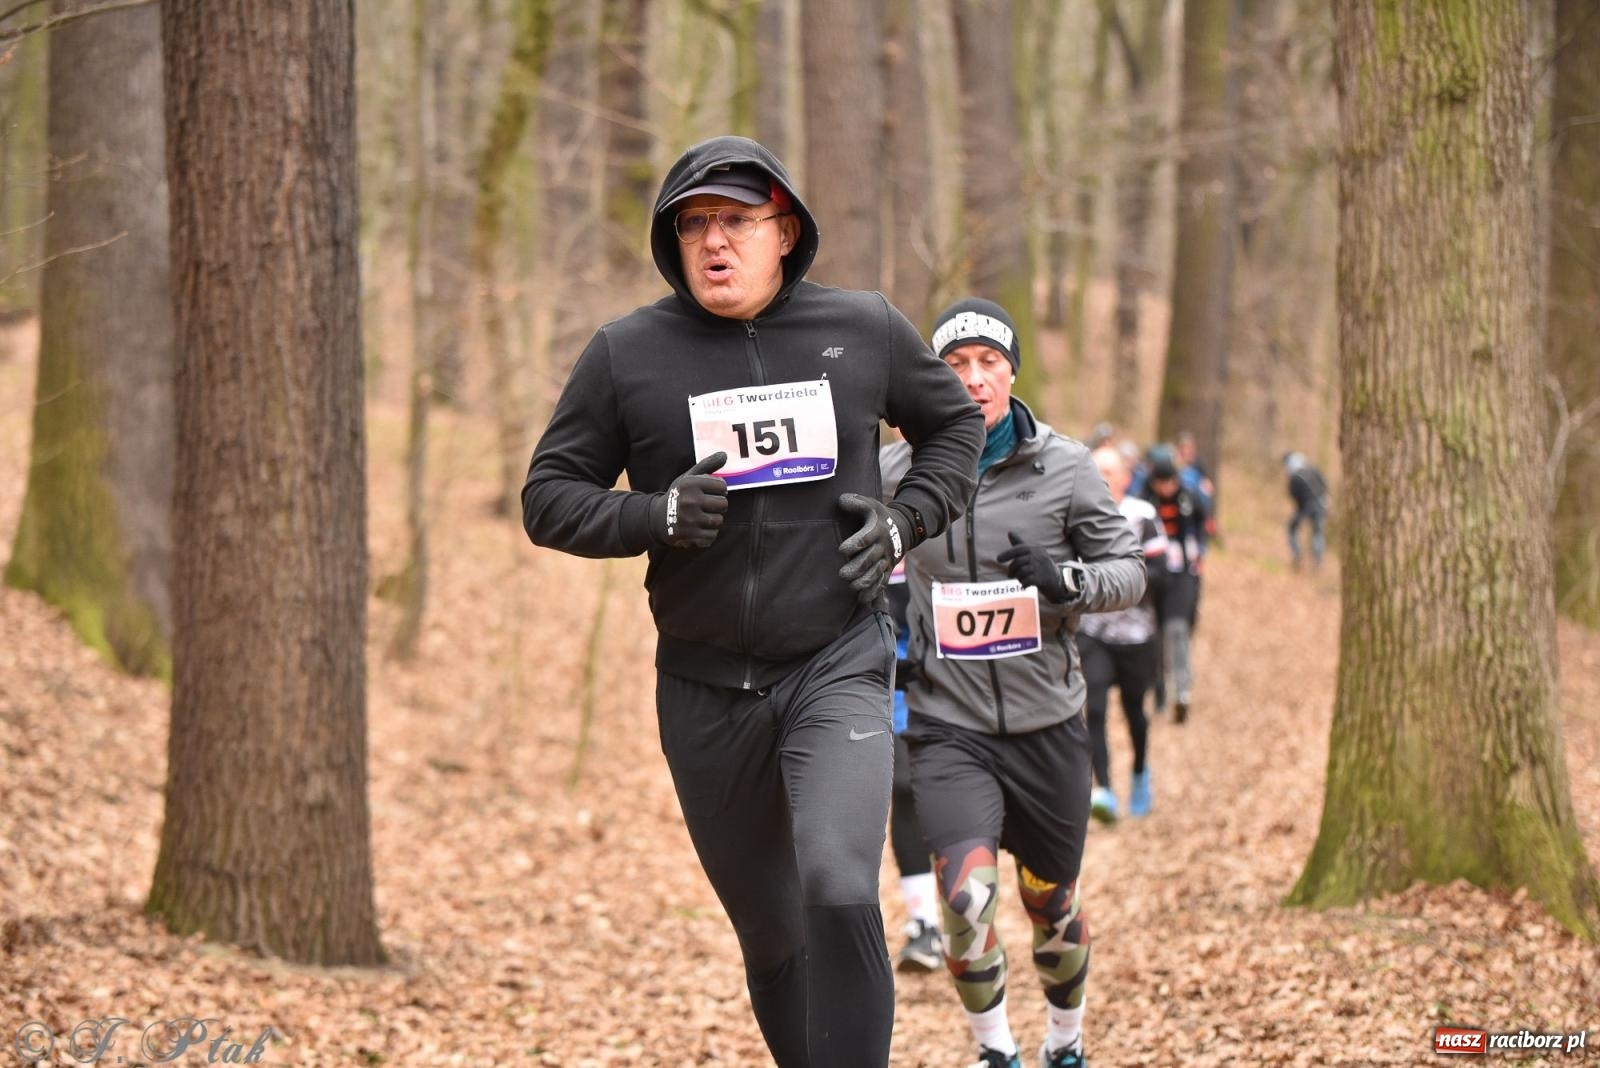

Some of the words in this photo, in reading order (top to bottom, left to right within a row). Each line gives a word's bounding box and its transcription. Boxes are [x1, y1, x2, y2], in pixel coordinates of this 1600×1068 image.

[821, 347, 844, 359] 4F
[737, 387, 818, 404] Twardziela
[732, 417, 799, 459] 151
[956, 607, 1015, 637] 077
